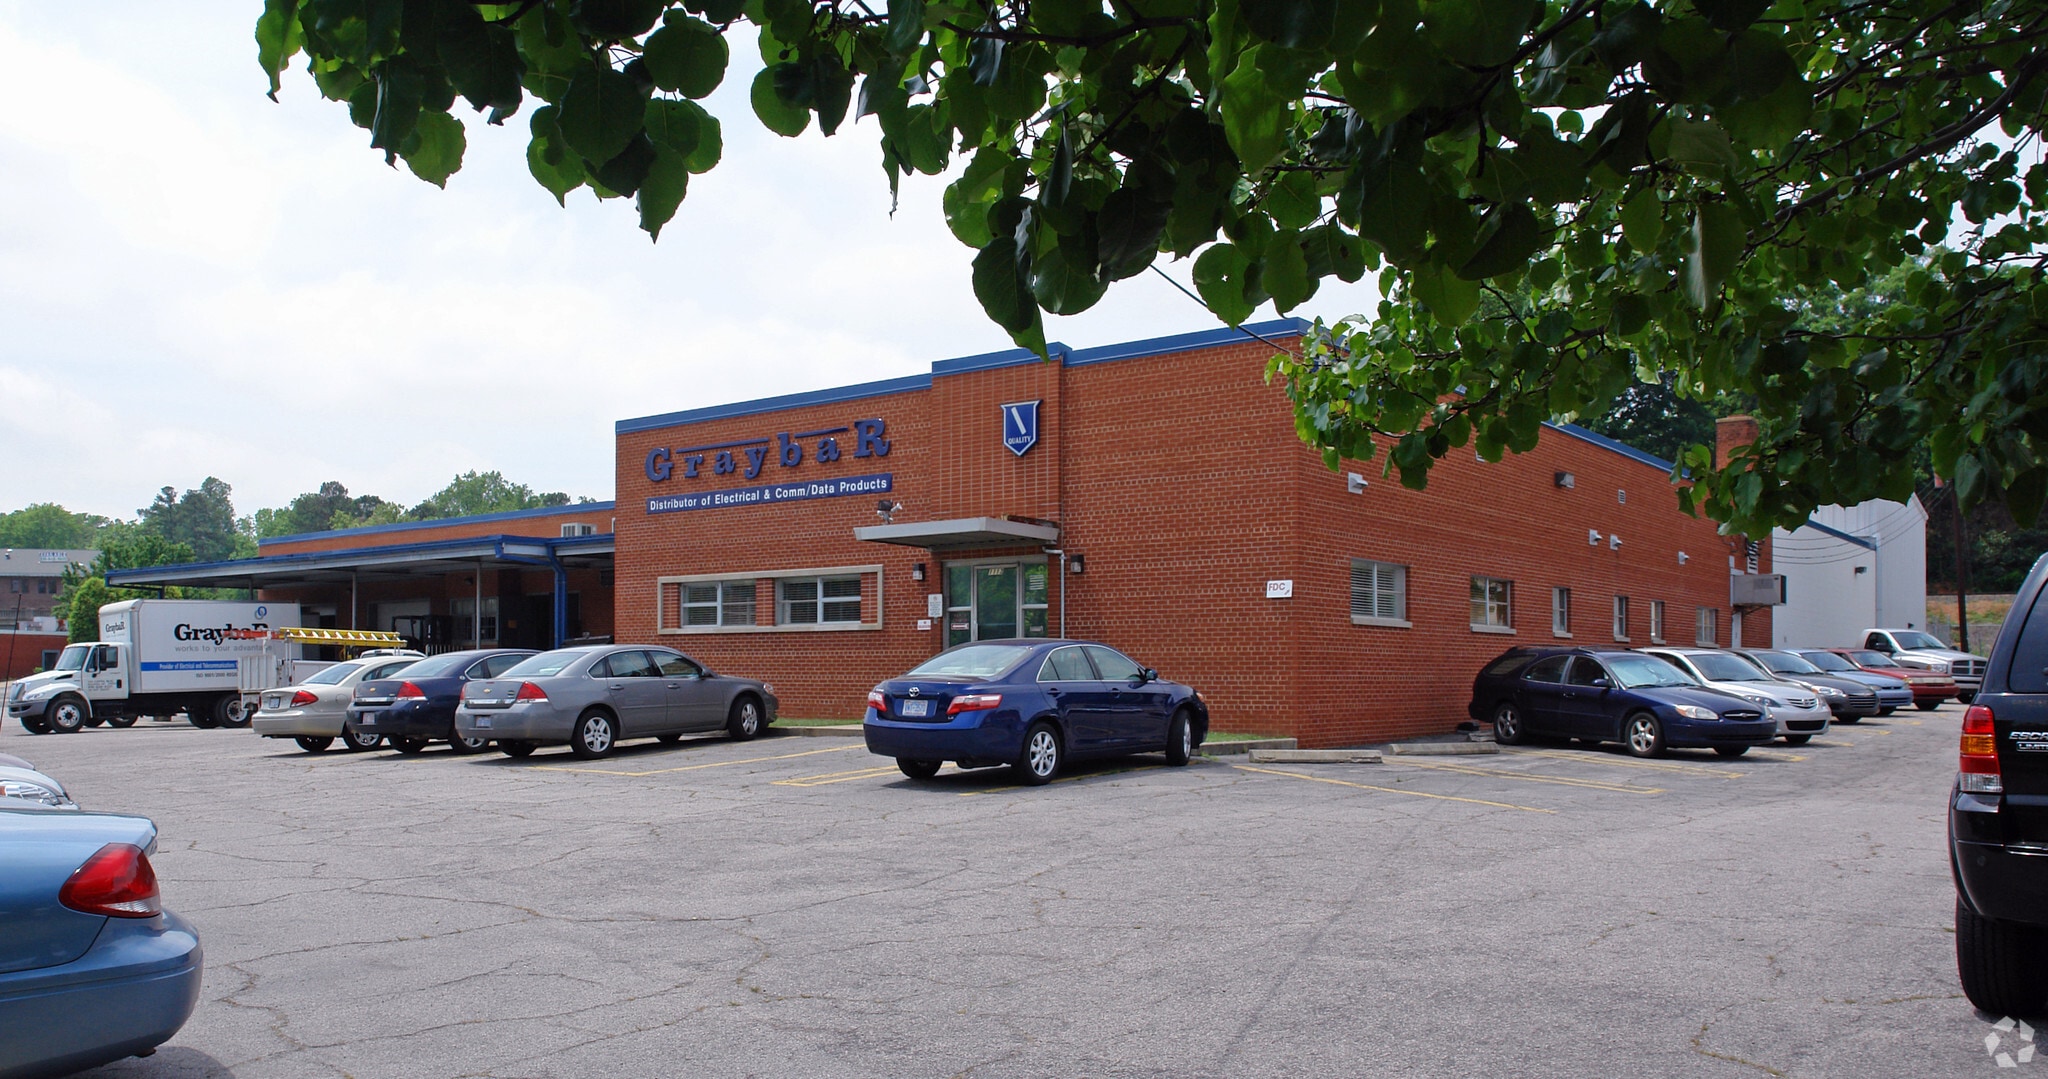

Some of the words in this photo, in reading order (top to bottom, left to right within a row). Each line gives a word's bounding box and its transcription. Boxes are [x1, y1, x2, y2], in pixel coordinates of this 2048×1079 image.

[1008, 435, 1031, 445] QUALITY
[644, 417, 891, 482] GraybaR
[650, 498, 697, 511] Distributor
[701, 495, 711, 506] of
[715, 490, 760, 505] Electrical
[763, 489, 771, 500] &
[775, 484, 835, 498] Comm/Data
[840, 478, 887, 493] Products
[1268, 582, 1286, 592] FDC
[214, 645, 231, 653] your
